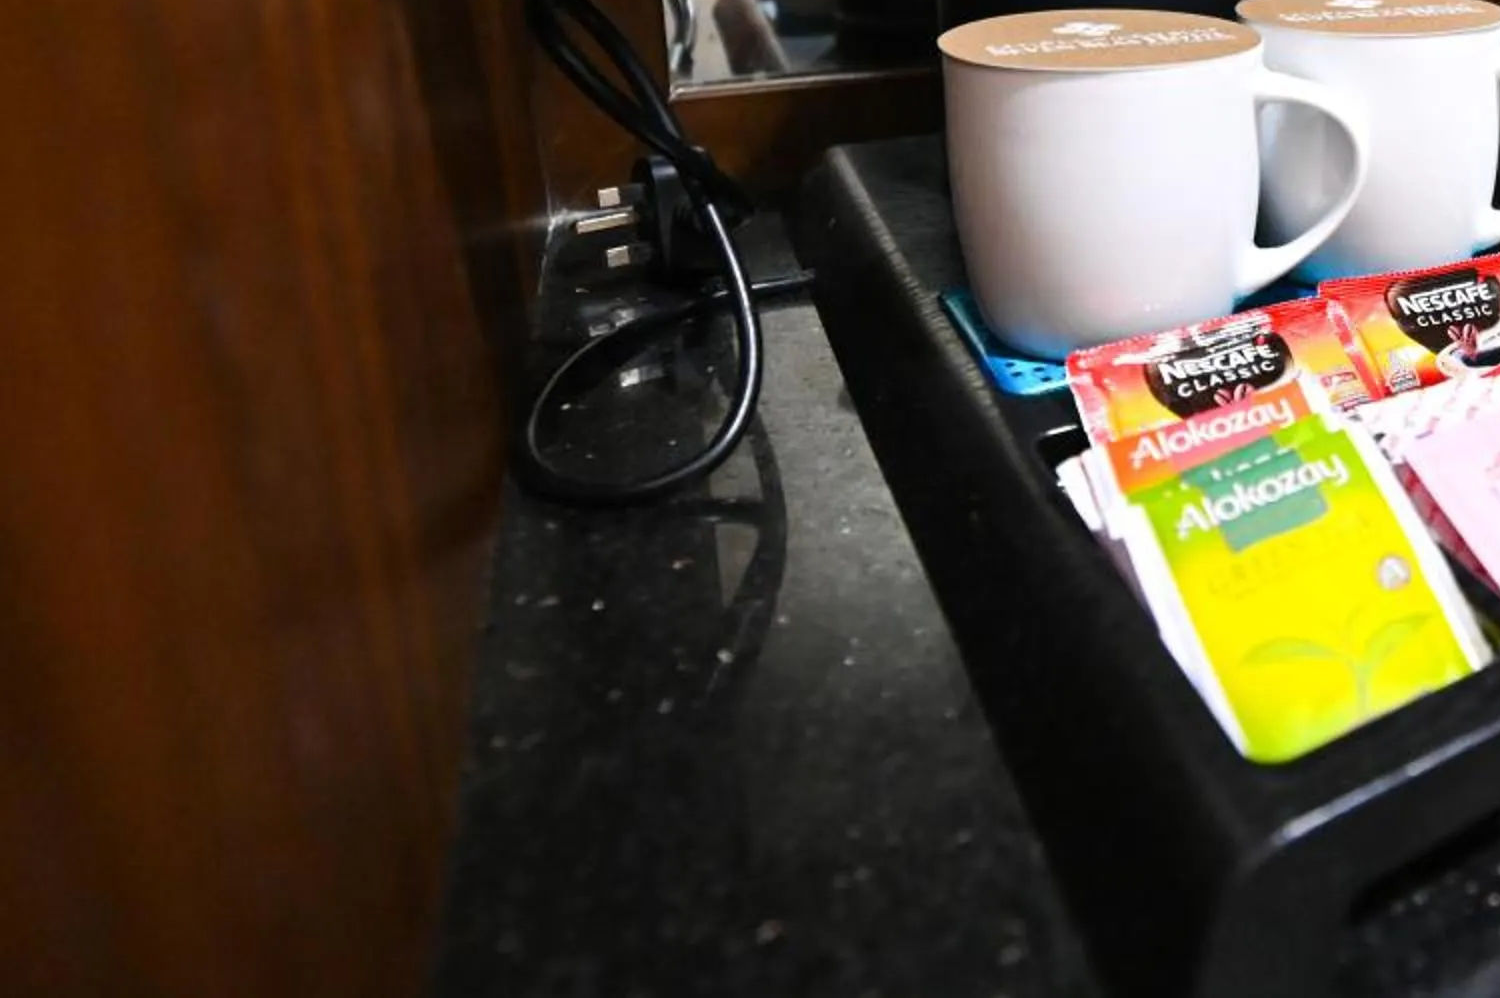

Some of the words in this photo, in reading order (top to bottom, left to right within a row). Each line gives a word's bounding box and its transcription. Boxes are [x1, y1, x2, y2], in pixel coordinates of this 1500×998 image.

[1416, 304, 1493, 327] CLASSIC
[1177, 360, 1275, 398] CLASSIC
[1130, 398, 1295, 470] Alokozay
[1176, 454, 1350, 541] Alokozay
